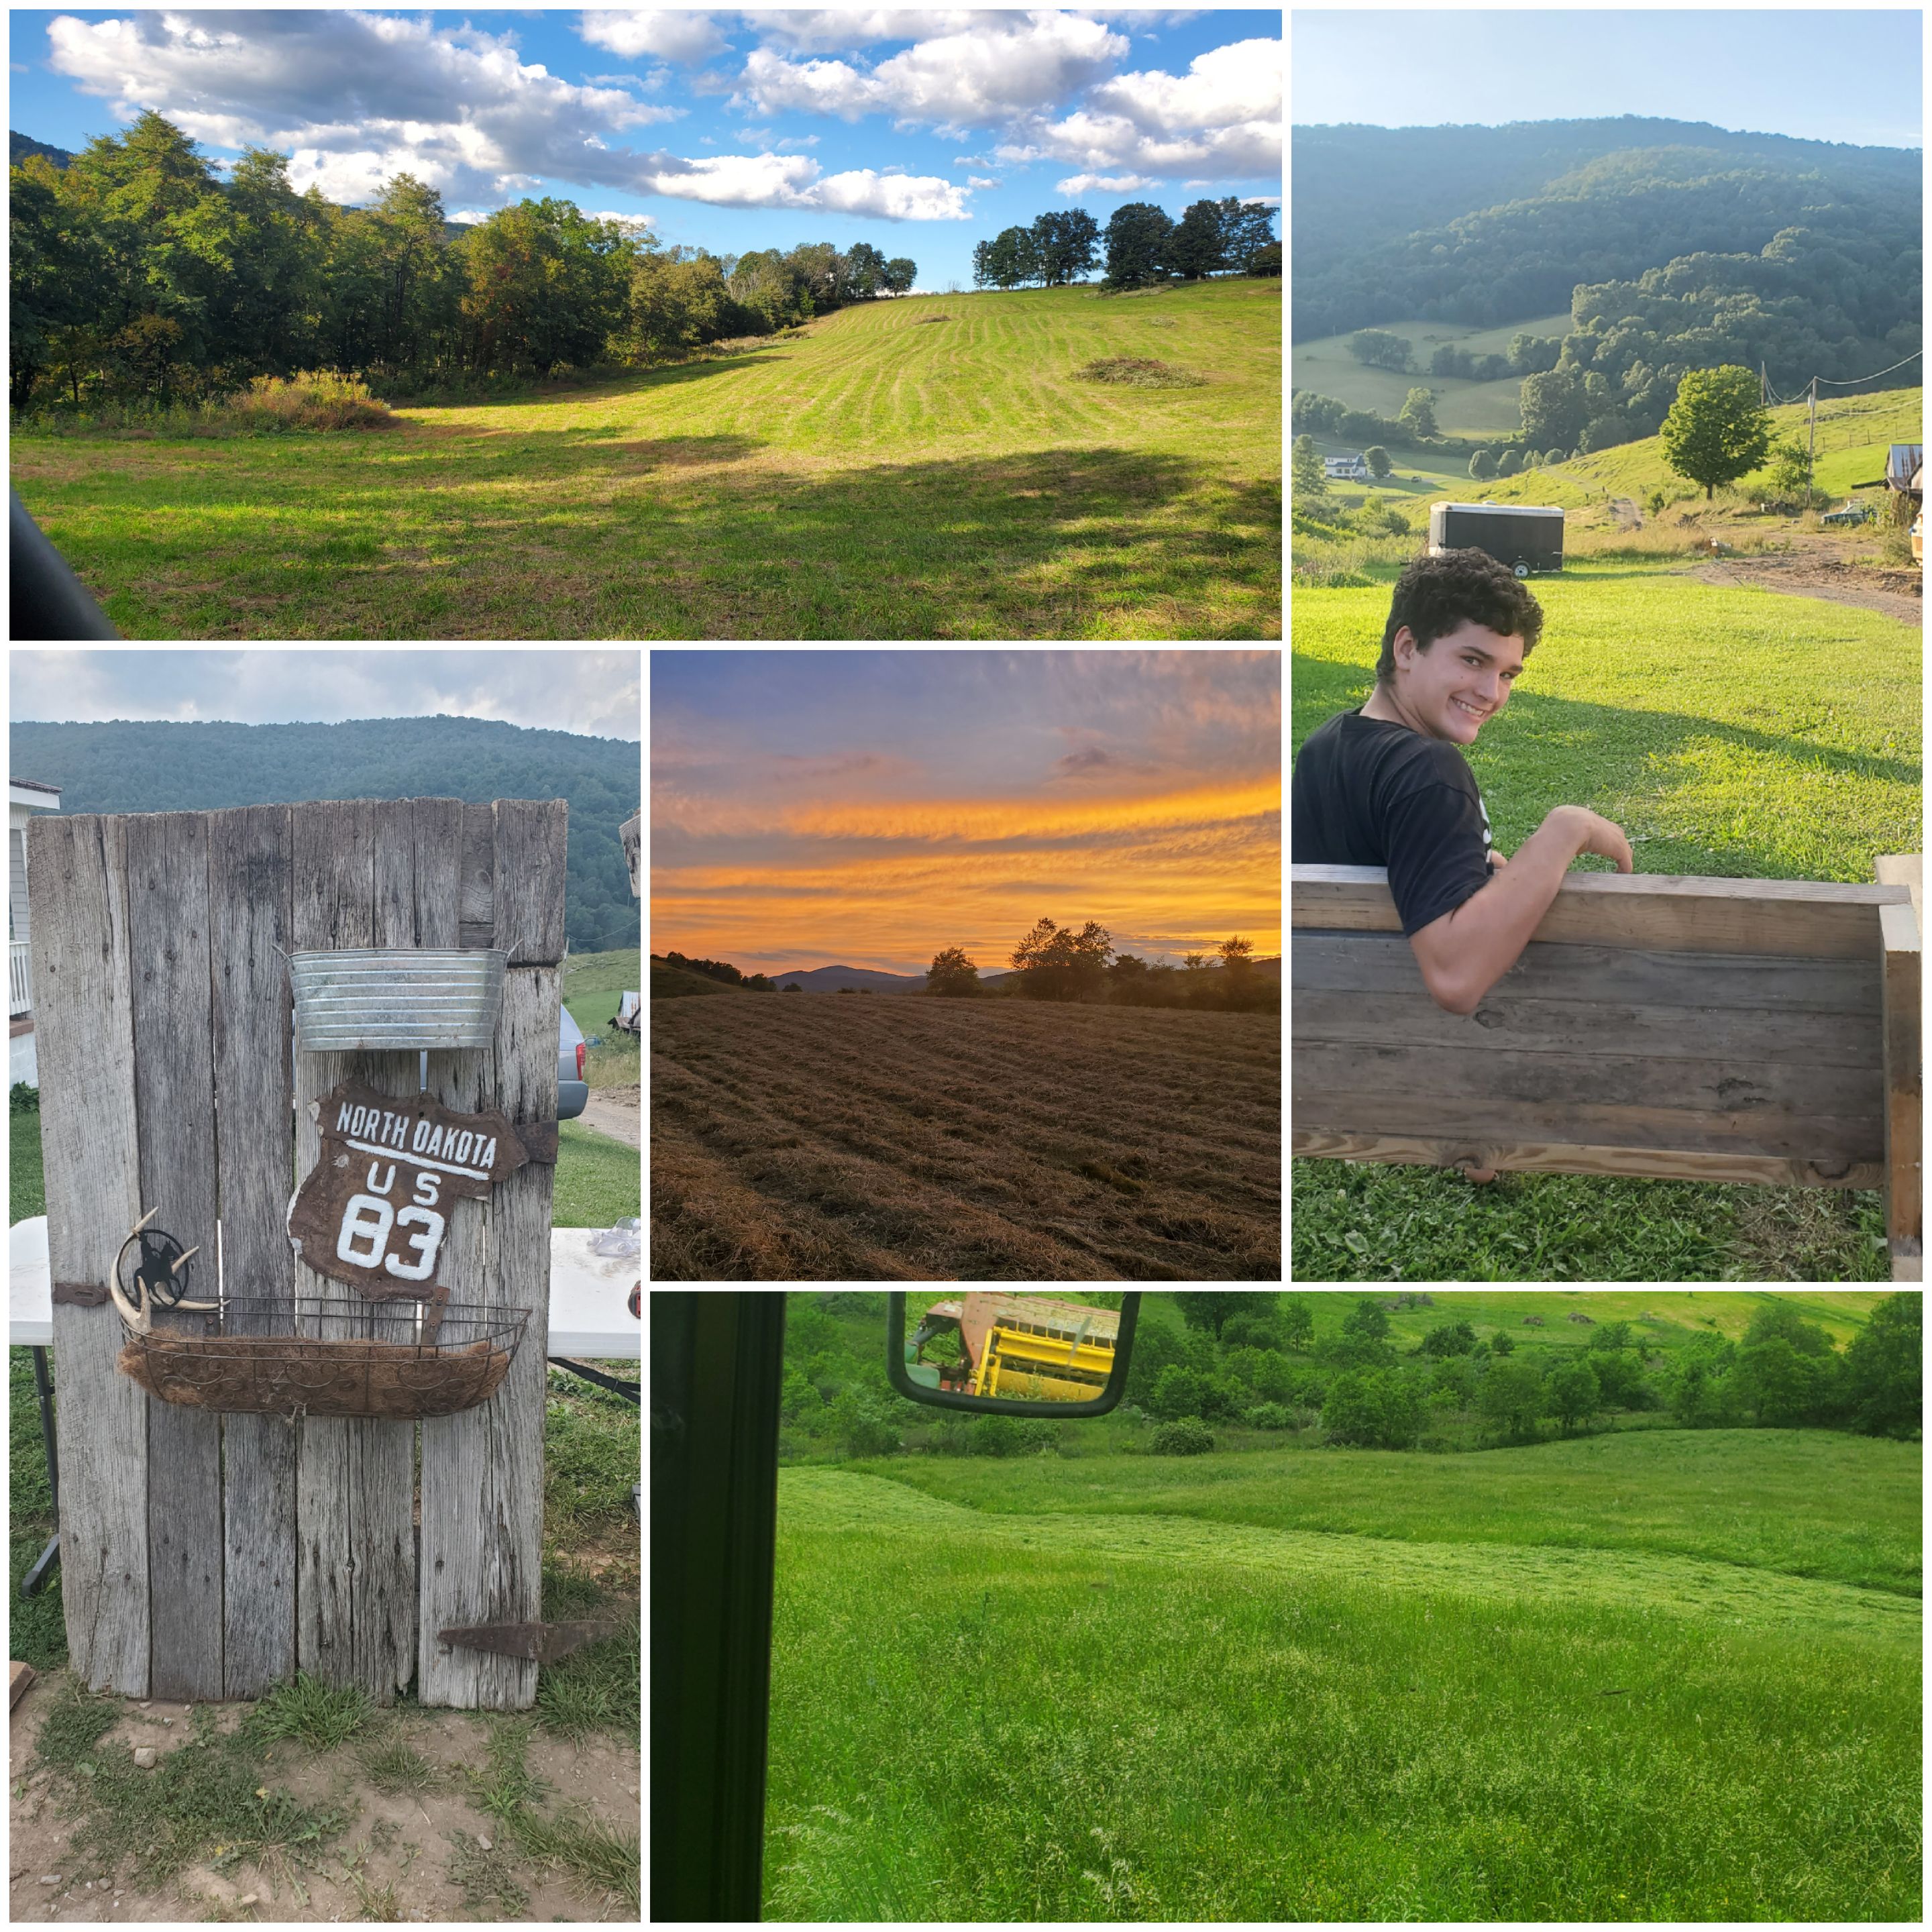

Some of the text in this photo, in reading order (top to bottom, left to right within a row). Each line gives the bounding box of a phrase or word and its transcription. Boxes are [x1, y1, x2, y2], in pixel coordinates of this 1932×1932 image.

[336, 1101, 497, 1169] NORTH DAKOTA
[337, 1194, 445, 1281] 83
